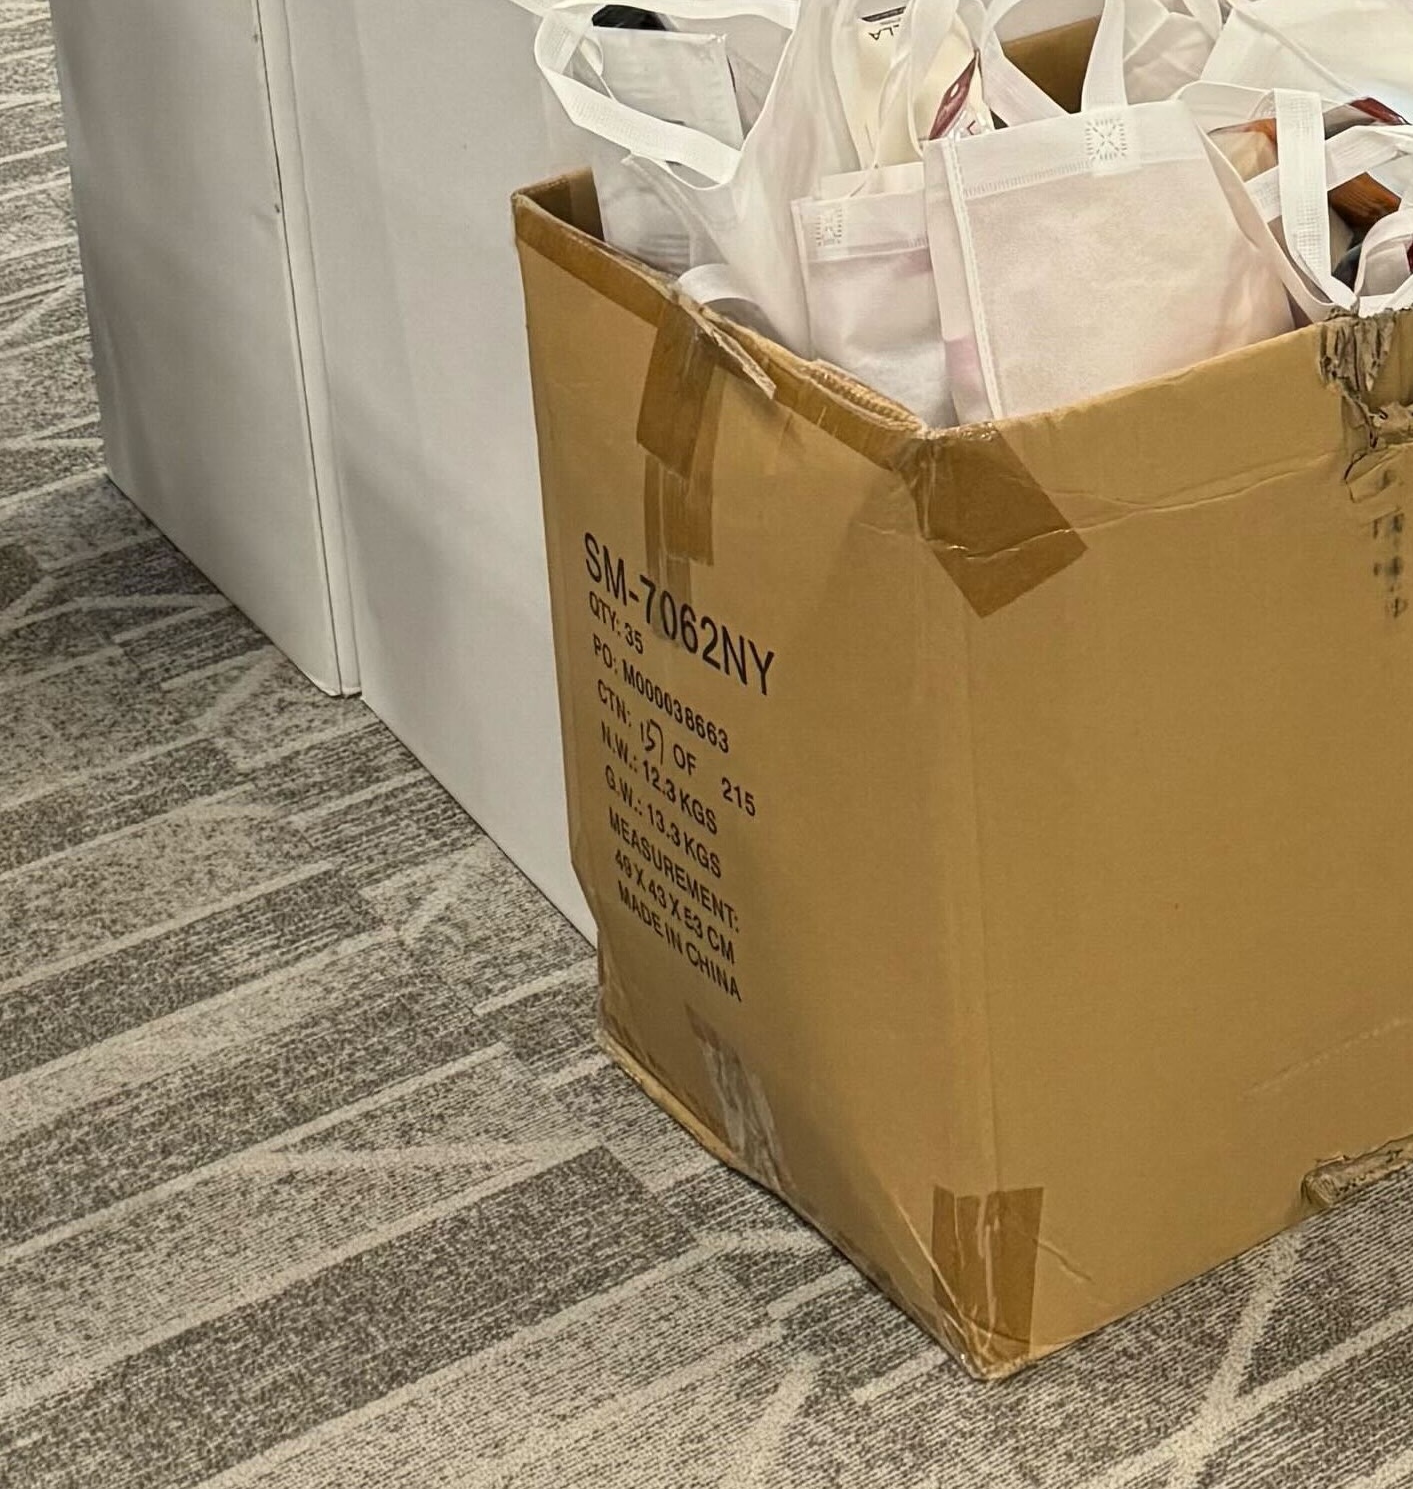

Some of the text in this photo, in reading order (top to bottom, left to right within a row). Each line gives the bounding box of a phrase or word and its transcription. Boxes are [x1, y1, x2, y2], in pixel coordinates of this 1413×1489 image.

[584, 532, 775, 696] SM-7062NY
[589, 591, 644, 655] QTY: 35
[593, 633, 730, 754] PO: M000038663
[598, 678, 756, 818] CTN: OF 215
[601, 721, 718, 835] N.W.: 12.3 KGS
[605, 764, 722, 879] G.W.: 13.3 KGS
[609, 806, 740, 933] MEASUREMENT:
[634, 863, 646, 892] X
[649, 878, 667, 909] 43
[669, 892, 682, 921] X
[707, 925, 735, 966] CM
[617, 879, 742, 1003] MADE IN CHINA
